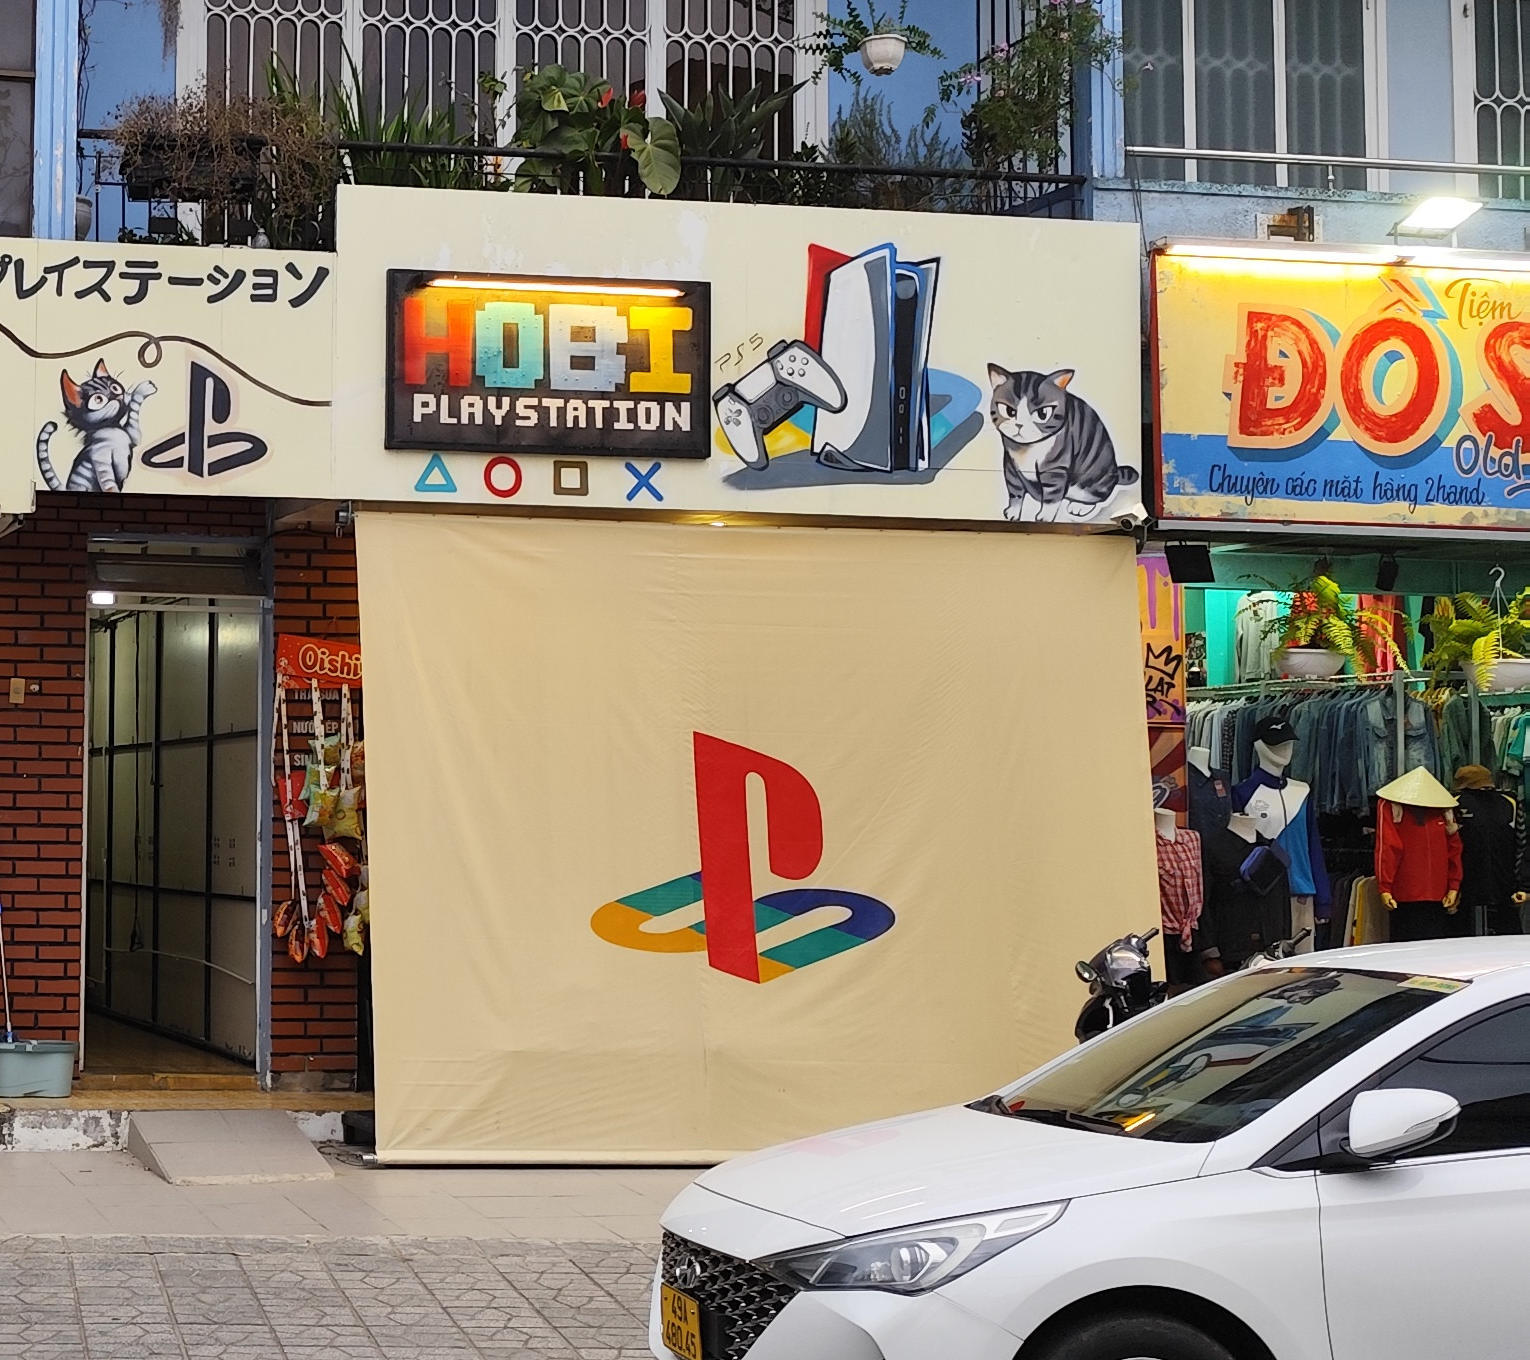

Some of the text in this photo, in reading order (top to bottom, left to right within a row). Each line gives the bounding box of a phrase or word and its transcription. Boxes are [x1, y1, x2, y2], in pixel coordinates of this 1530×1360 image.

[1445, 277, 1523, 329] Tiệm
[402, 296, 693, 393] HOBI
[714, 333, 764, 372] PS5
[412, 392, 691, 432] PLAYSTATION
[1209, 464, 1486, 514] Chuyên các mặt hàng 2hand
[299, 644, 362, 679] Oishi
